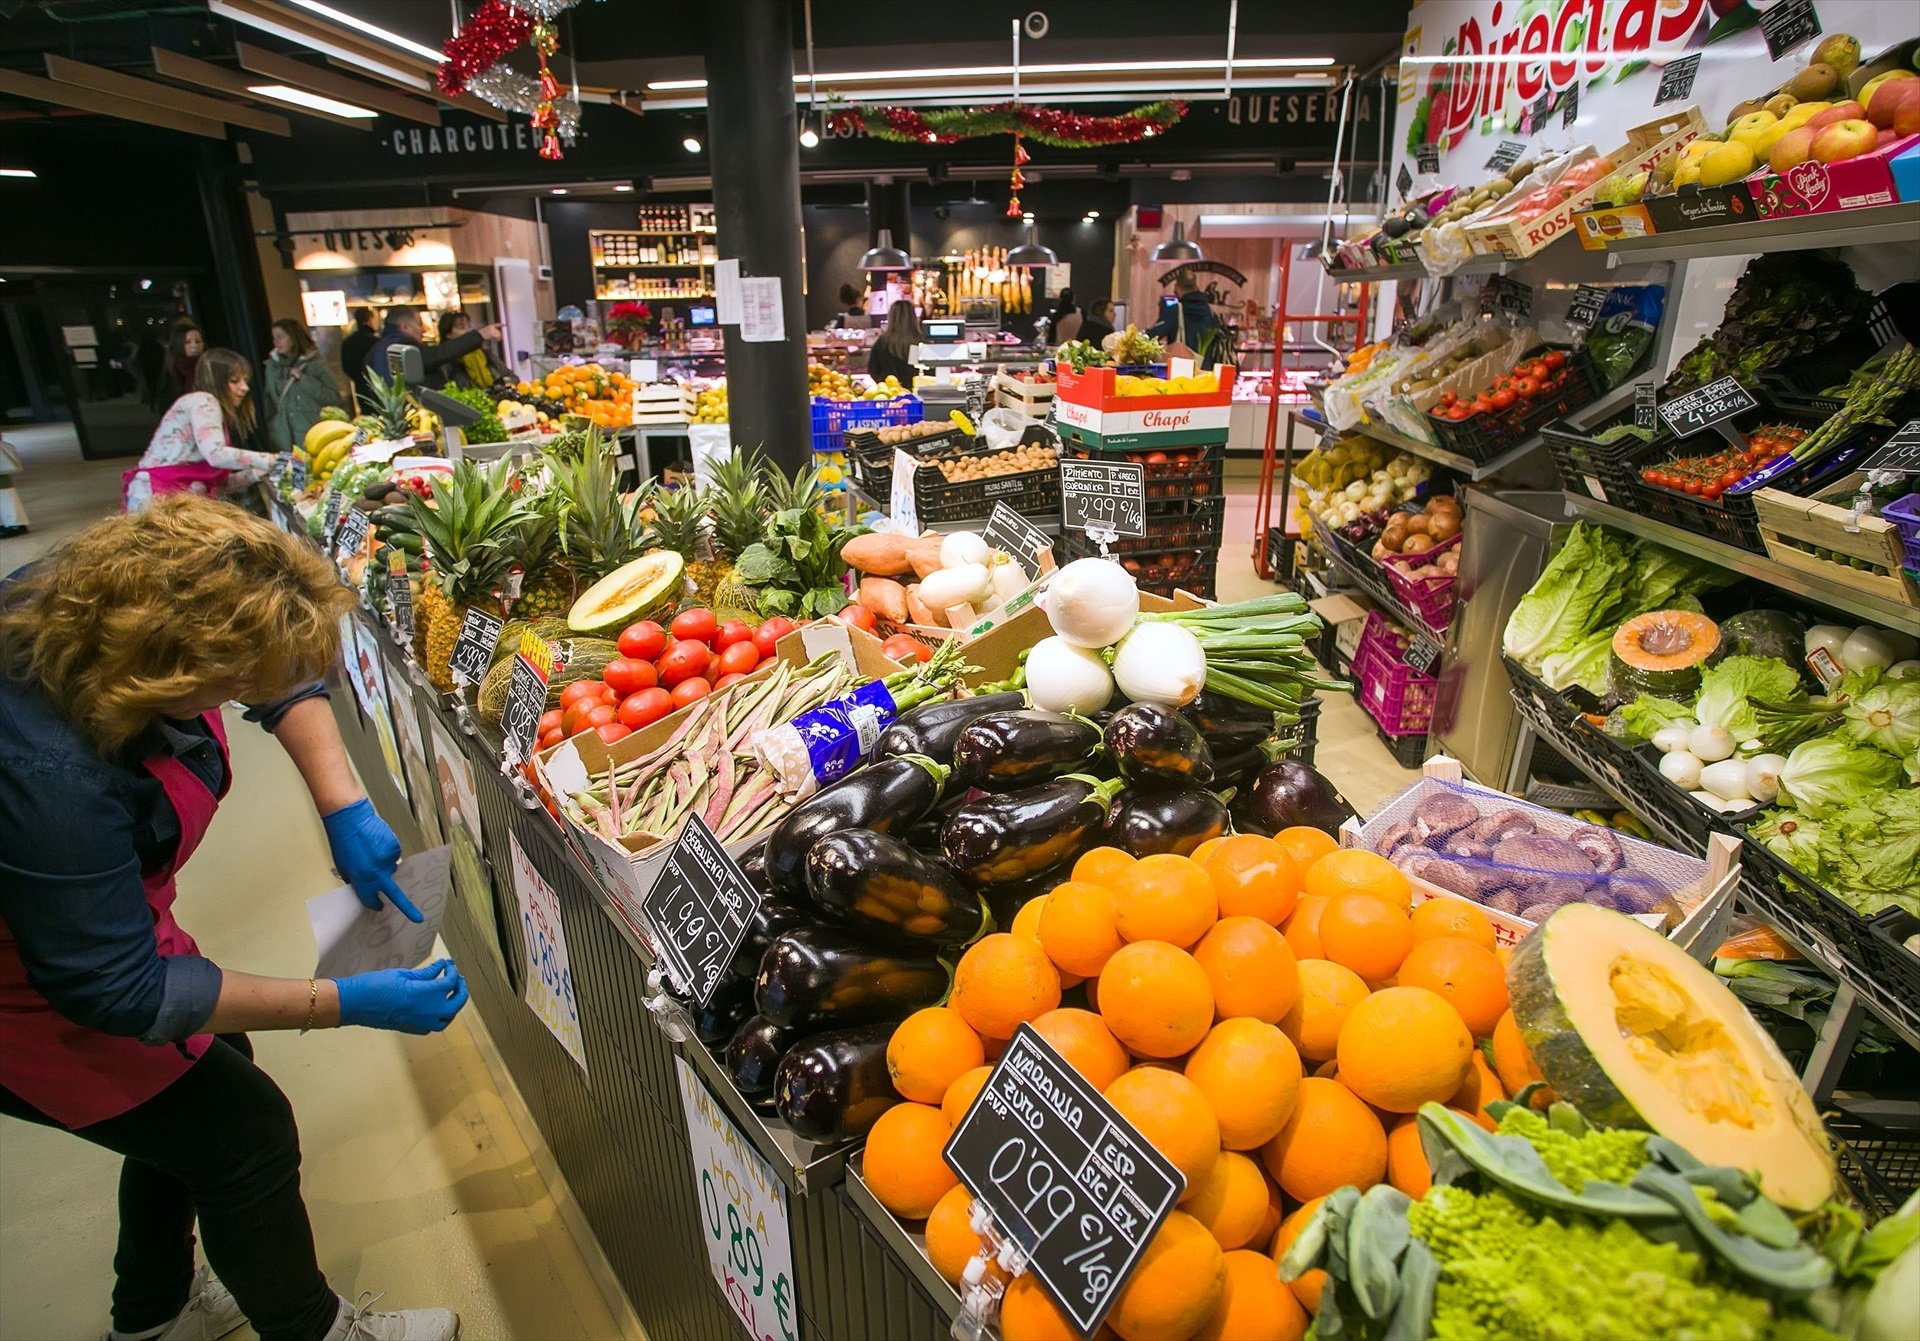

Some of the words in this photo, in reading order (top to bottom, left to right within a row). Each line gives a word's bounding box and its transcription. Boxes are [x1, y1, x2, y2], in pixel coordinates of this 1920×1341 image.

[1795, 166, 1820, 190] Pink
[1803, 177, 1826, 198] Lady
[323, 230, 415, 252] QUESS
[1143, 410, 1191, 431] Chapó
[1688, 400, 1727, 424] 4'98
[1065, 469, 1103, 480] PIMIENTO
[1078, 497, 1116, 523] 2'99
[684, 827, 724, 882] BERENJENA
[514, 843, 560, 924] TOMATE
[528, 892, 558, 952] PERA
[562, 967, 576, 1021] €
[1020, 1037, 1042, 1060] PRODUCTO
[984, 1090, 1008, 1121] P.V.P.
[1012, 1050, 1083, 1130] NARANJA
[684, 1065, 784, 1218] NARANJA
[1104, 1143, 1136, 1185] ESP.
[710, 1147, 769, 1248] HOJA
[989, 1137, 1076, 1241] 0'99
[1111, 1202, 1138, 1238] EX.
[703, 1169, 764, 1298] 0,89
[772, 1272, 794, 1341] €
[722, 1264, 776, 1341] KIL
